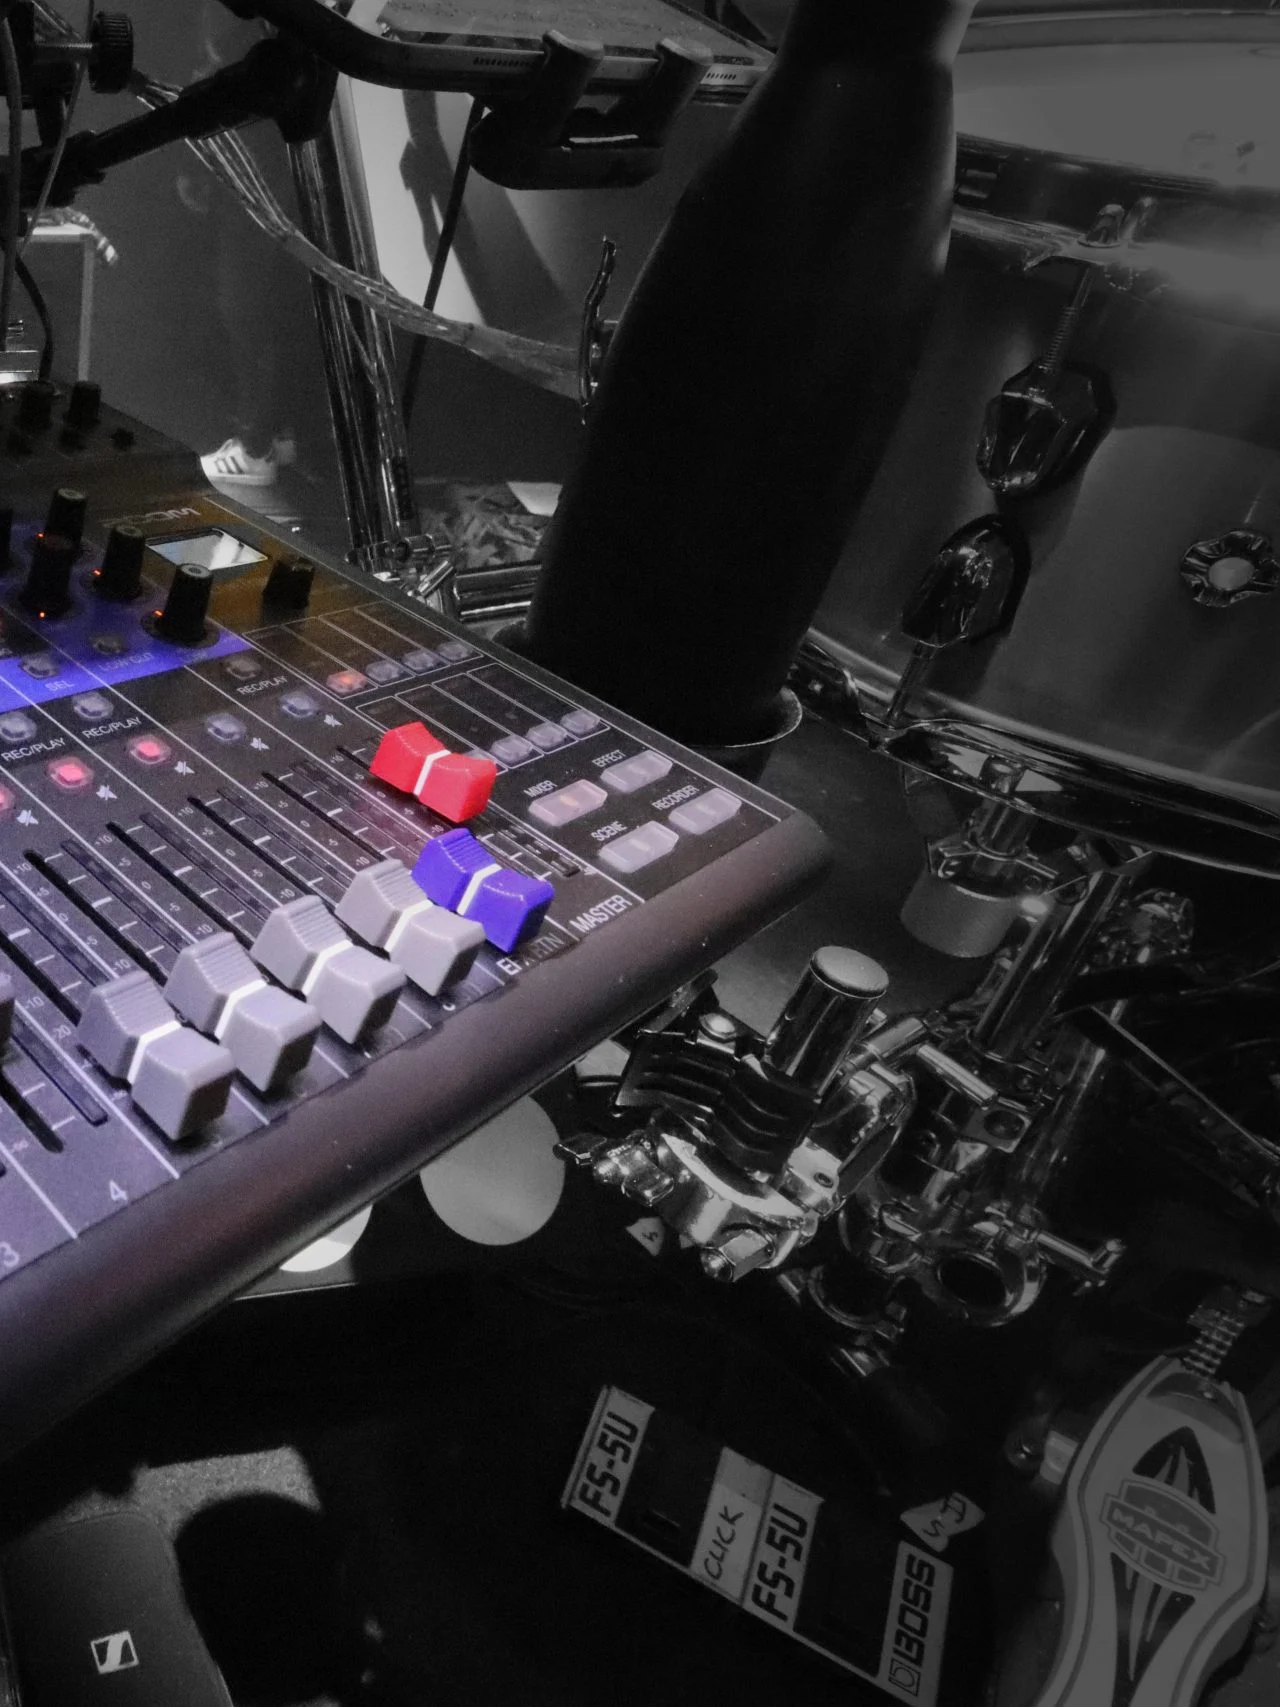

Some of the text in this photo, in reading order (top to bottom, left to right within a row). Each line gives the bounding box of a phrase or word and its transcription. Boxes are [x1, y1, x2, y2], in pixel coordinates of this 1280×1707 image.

[44, 679, 75, 692] SEL
[236, 674, 289, 696] REC/PLAY
[81, 716, 143, 739] REC/PLAY
[0, 736, 67, 762] REC/PLAY
[591, 749, 627, 768] EFFECT
[524, 780, 558, 800] MIXER
[651, 785, 700, 811] RECORDER
[590, 821, 628, 842] SCENE
[569, 894, 633, 933] MASTER
[108, 1179, 129, 1203] 4
[579, 1411, 638, 1517] FS-5U
[704, 1505, 744, 1580] CLICK
[1111, 1507, 1212, 1571] MAPEX
[751, 1503, 808, 1622] FS-5U
[892, 1553, 935, 1668] BOSS
